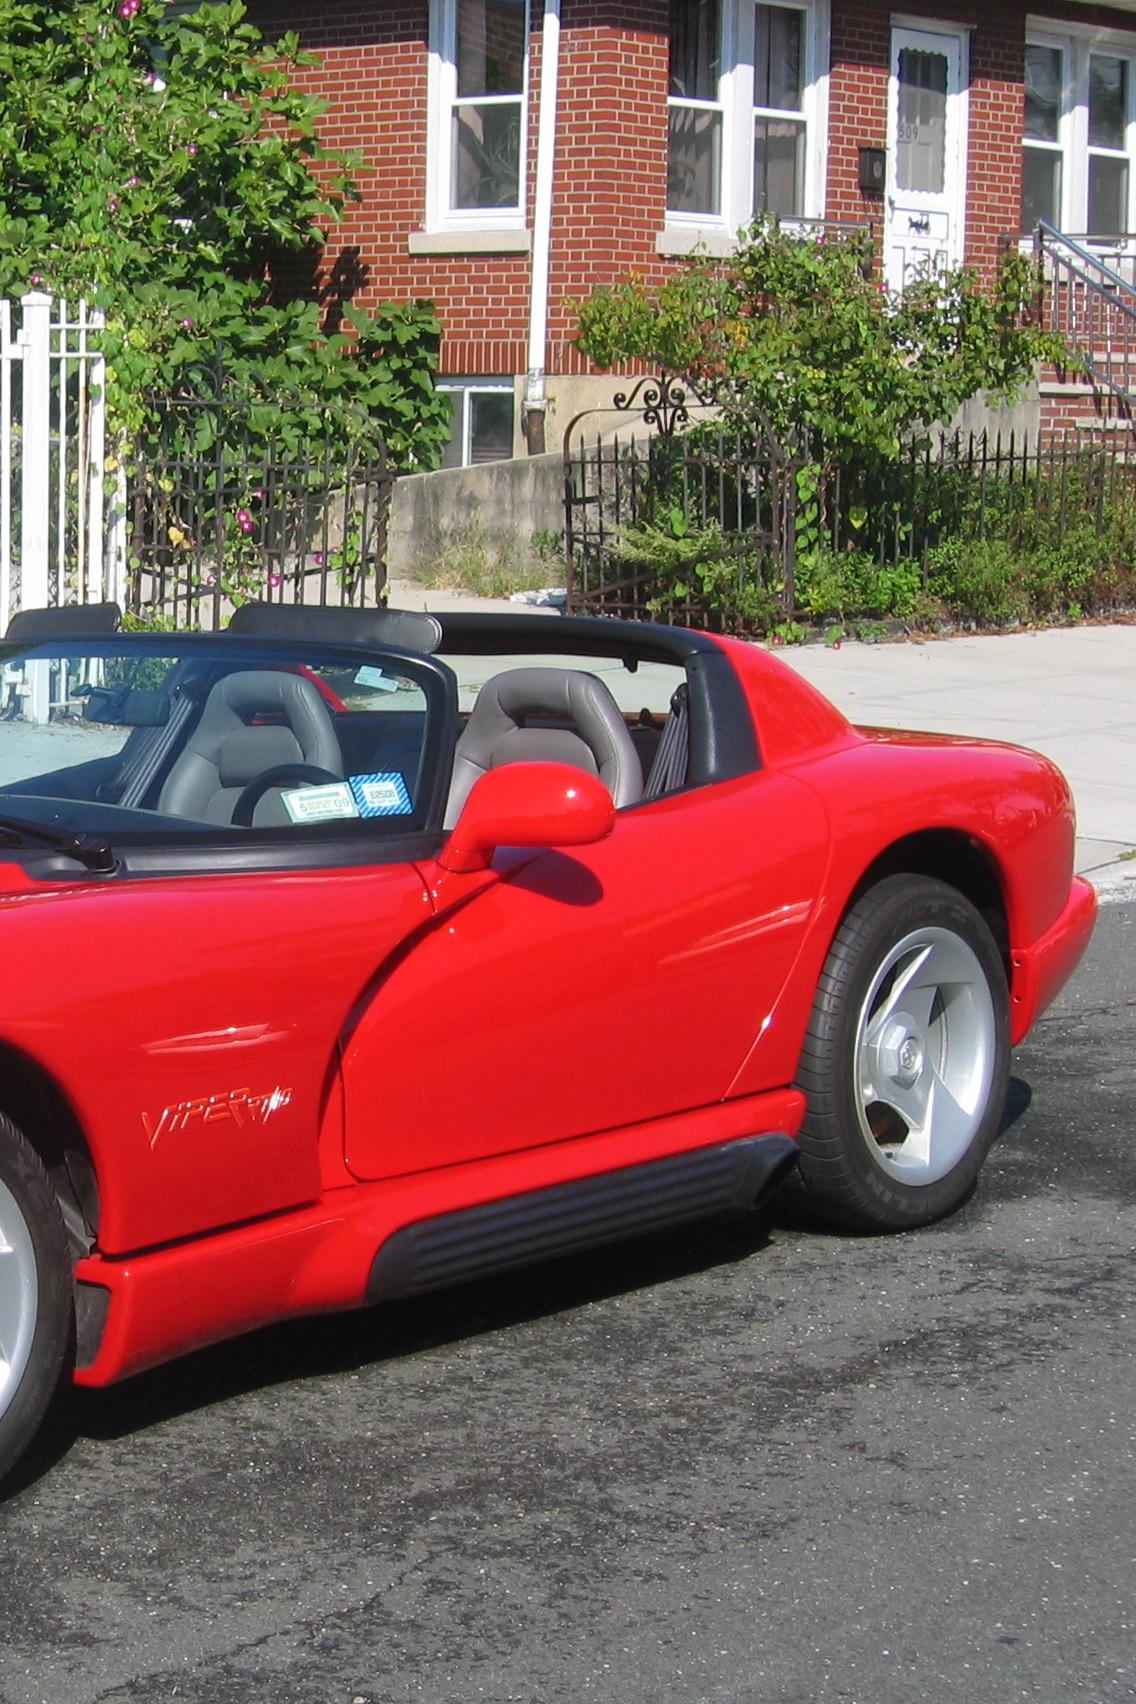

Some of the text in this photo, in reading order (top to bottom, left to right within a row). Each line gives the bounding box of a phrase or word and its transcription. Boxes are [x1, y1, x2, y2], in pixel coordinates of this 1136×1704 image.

[899, 124, 918, 138] 509
[300, 803, 308, 814] 5
[141, 1088, 250, 1151] VIPER
